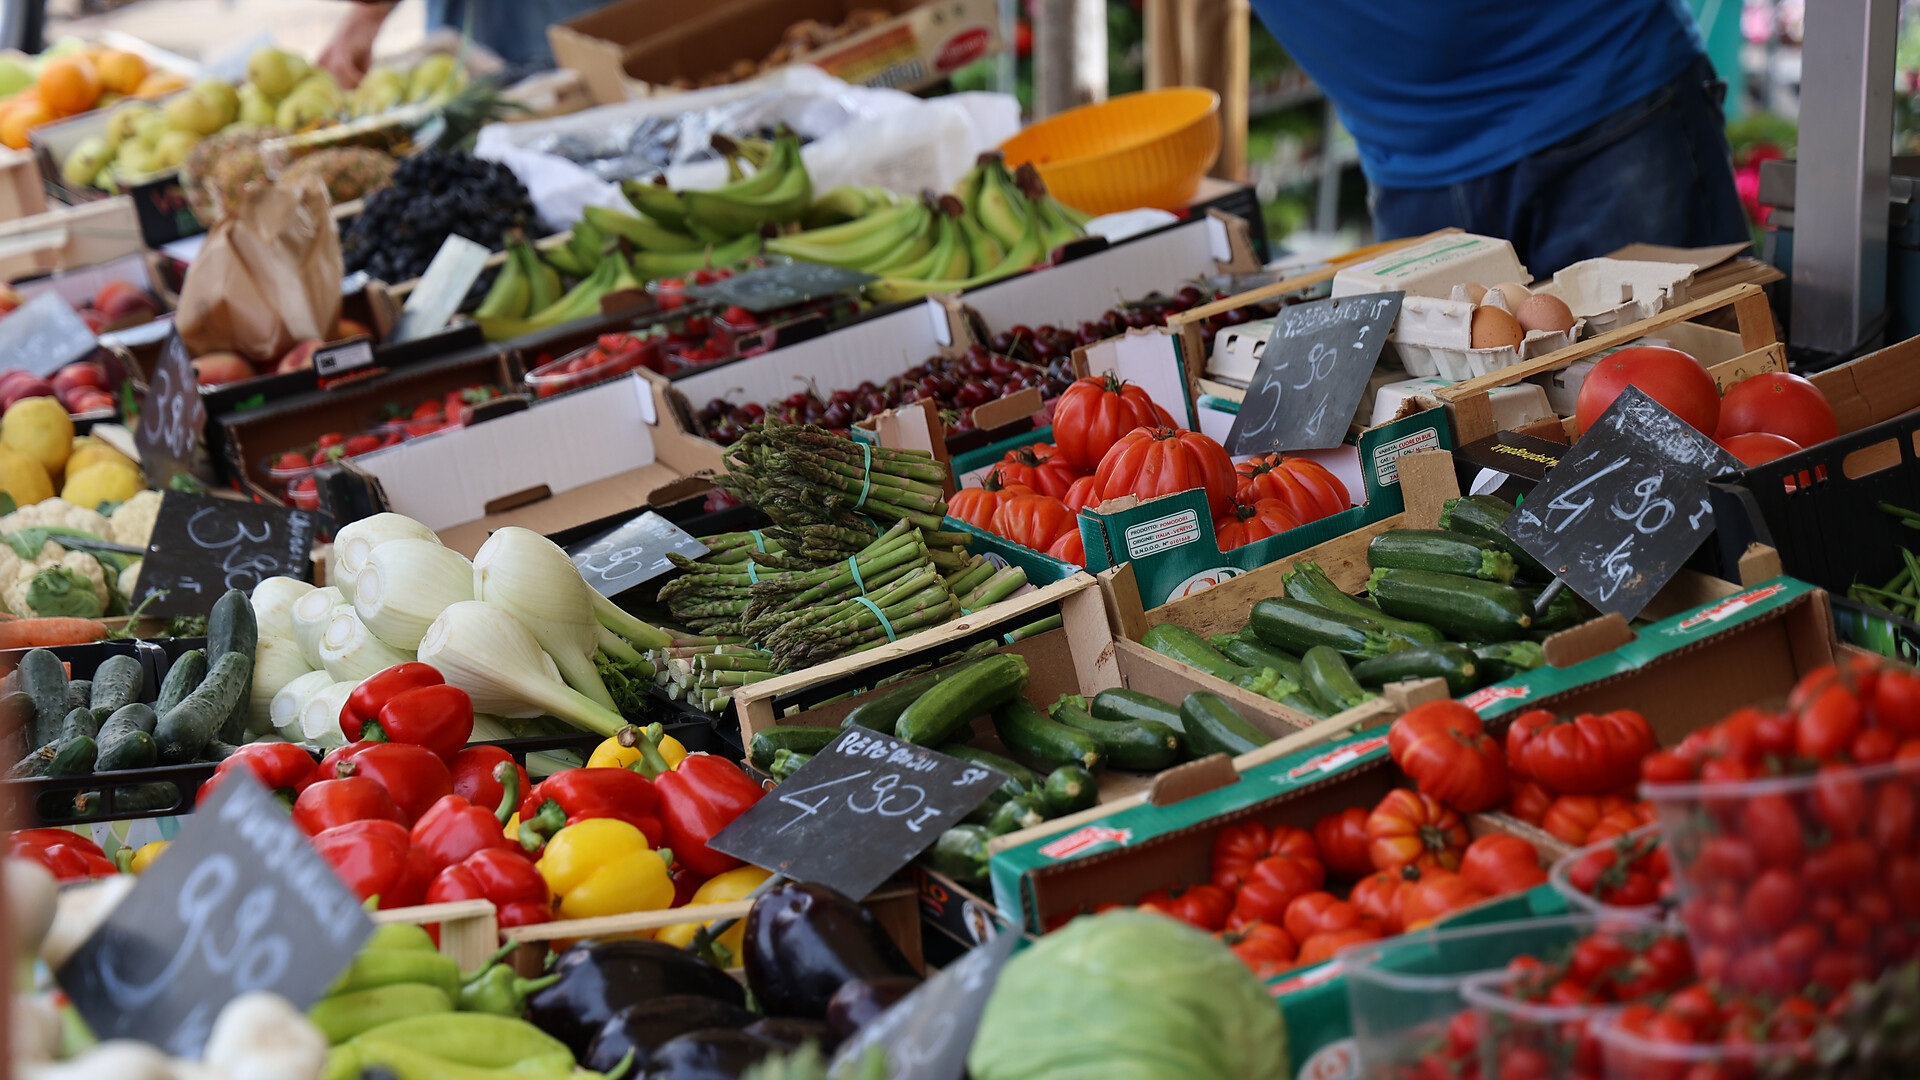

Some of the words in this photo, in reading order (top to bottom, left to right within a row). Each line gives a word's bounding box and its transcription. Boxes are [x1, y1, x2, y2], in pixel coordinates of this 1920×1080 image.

[1398, 439, 1416, 449] CUORE
[1380, 465, 1396, 473] LOTTO
[1130, 524, 1159, 536] PRODOTTO:
[1159, 516, 1188, 527] POMODORI
[1132, 535, 1155, 545] ORIGINE:
[1155, 531, 1171, 540] ITALIA
[1172, 524, 1193, 534] VENETO
